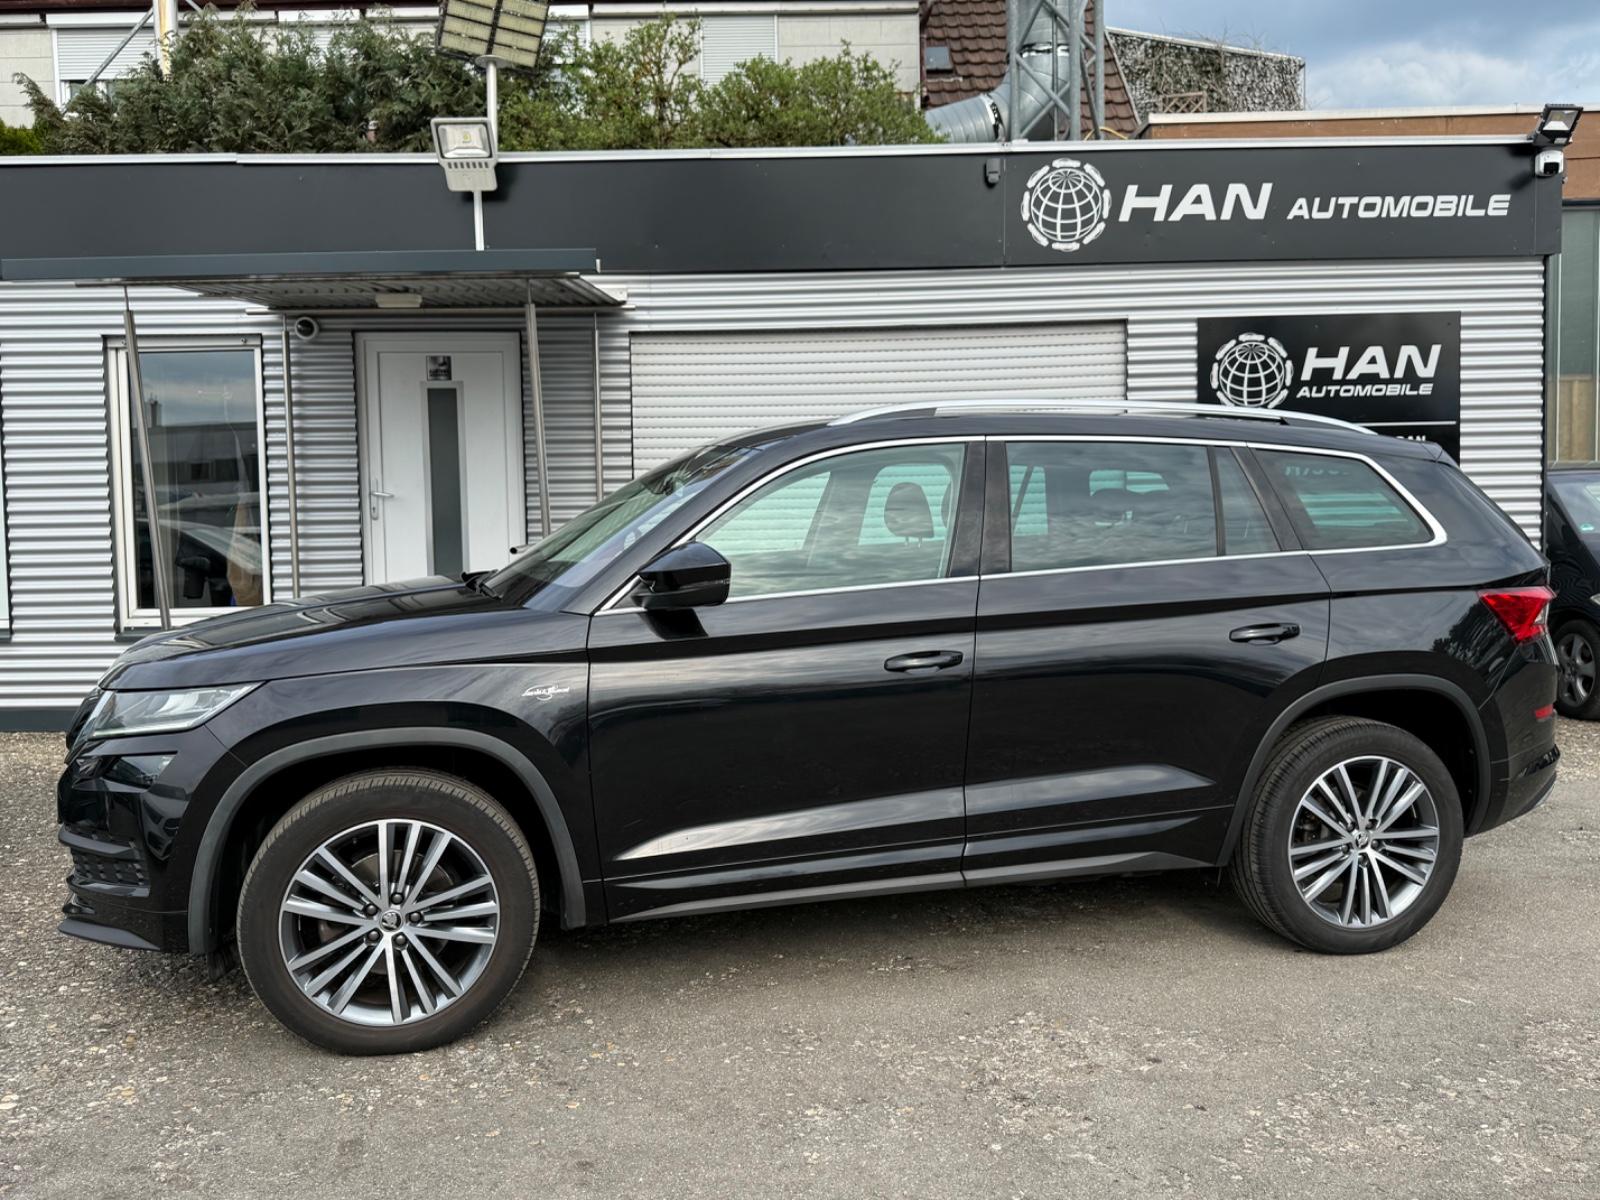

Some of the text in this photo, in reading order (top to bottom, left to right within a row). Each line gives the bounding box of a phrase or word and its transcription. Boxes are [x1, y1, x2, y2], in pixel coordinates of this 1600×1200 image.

[1118, 182, 1512, 223] HAN AUTOMOBILE
[1300, 343, 1442, 381] HAN
[1296, 383, 1434, 398] AUTOMOBILE
